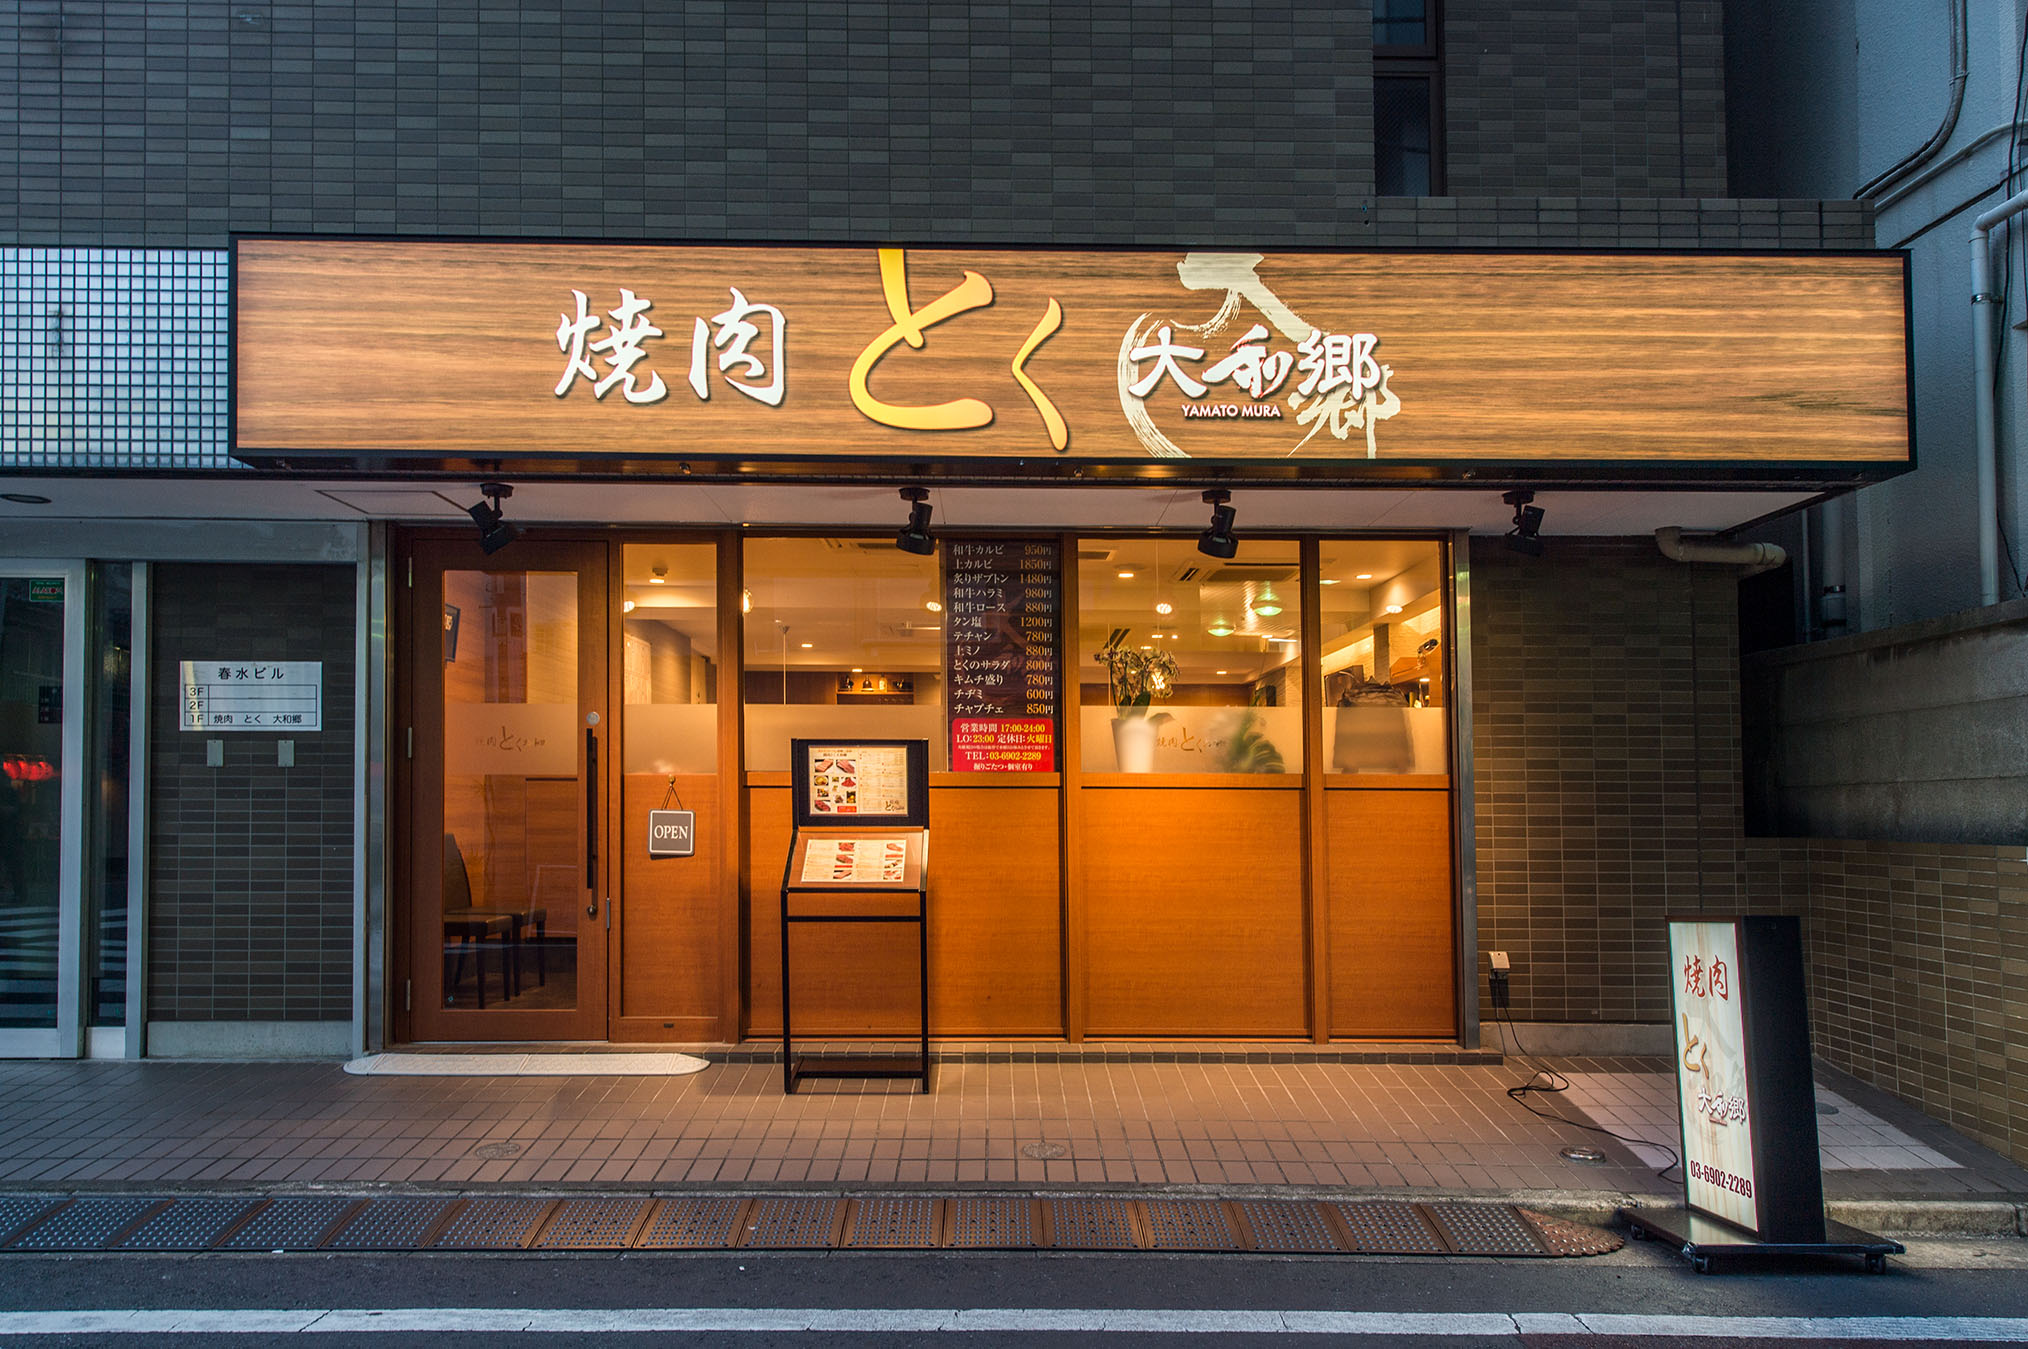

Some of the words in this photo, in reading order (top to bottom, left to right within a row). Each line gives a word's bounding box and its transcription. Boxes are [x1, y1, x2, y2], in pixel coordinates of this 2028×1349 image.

[554, 286, 786, 407] 焼肉
[849, 248, 1069, 451] とく
[1128, 324, 1382, 400] 大和郷
[1181, 404, 1238, 418] YAMATO
[1241, 405, 1281, 418] MURA
[954, 545, 1004, 556] 和牛カルビ
[1025, 545, 1051, 555] 950円
[956, 559, 993, 570] 上カルビ
[1020, 560, 1051, 570] 1850円
[1020, 574, 1051, 584] 1480円
[954, 587, 1003, 599] 和牛ハラミ
[1025, 588, 1052, 599] 980円
[954, 602, 1006, 613] 和牛ロース
[1026, 603, 1052, 613] 880円
[954, 616, 982, 627] タン塩
[1021, 617, 1052, 627] 1200円
[954, 631, 992, 642] テチャン
[1026, 631, 1052, 642] 780円
[957, 645, 980, 656] 上ミノ
[1026, 646, 1052, 657] 880円
[954, 660, 1010, 671] とくのサラダ
[1026, 660, 1052, 671] 800円
[218, 667, 284, 680] 春水ビル
[954, 674, 1003, 685] キムチ盛り
[1026, 675, 1053, 685] 780円
[189, 687, 204, 697] 3F
[1026, 689, 1053, 699] 600円
[189, 701, 204, 710] 2F
[1026, 704, 1053, 714] 850円
[190, 714, 204, 724] 1F
[213, 714, 233, 724] 焼肉
[244, 715, 262, 724] とく
[273, 714, 302, 724] 大和郷
[960, 723, 997, 733] 営業時間
[653, 825, 688, 839] OPEN
[1684, 955, 1729, 1001] 焼肉
[1682, 1012, 1709, 1080] とく
[1697, 1087, 1746, 1125] 大和郷
[1690, 1160, 1753, 1199] 03-6902-2289
